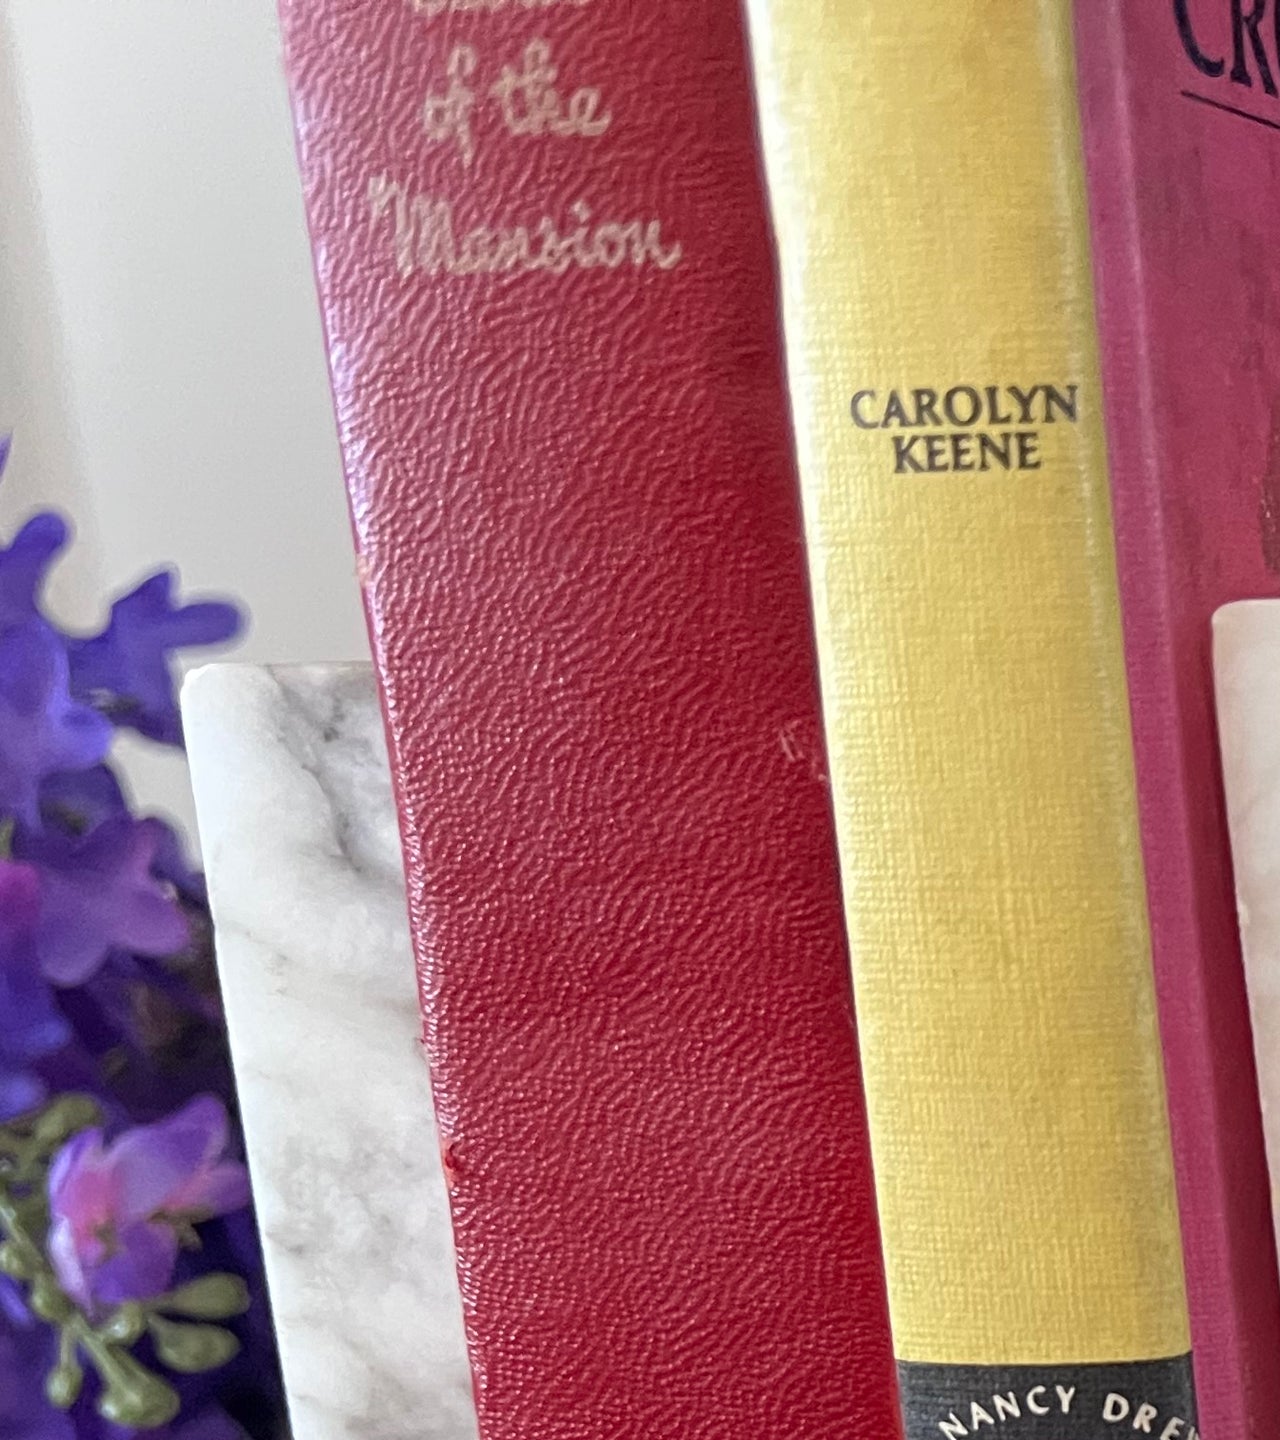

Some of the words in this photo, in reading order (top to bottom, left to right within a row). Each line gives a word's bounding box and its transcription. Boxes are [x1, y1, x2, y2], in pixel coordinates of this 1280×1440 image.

[423, 44, 474, 168] of
[490, 40, 612, 135] the
[367, 173, 683, 277] Mansion
[850, 384, 1078, 429] CAROLYN
[893, 432, 1041, 473] KEENE
